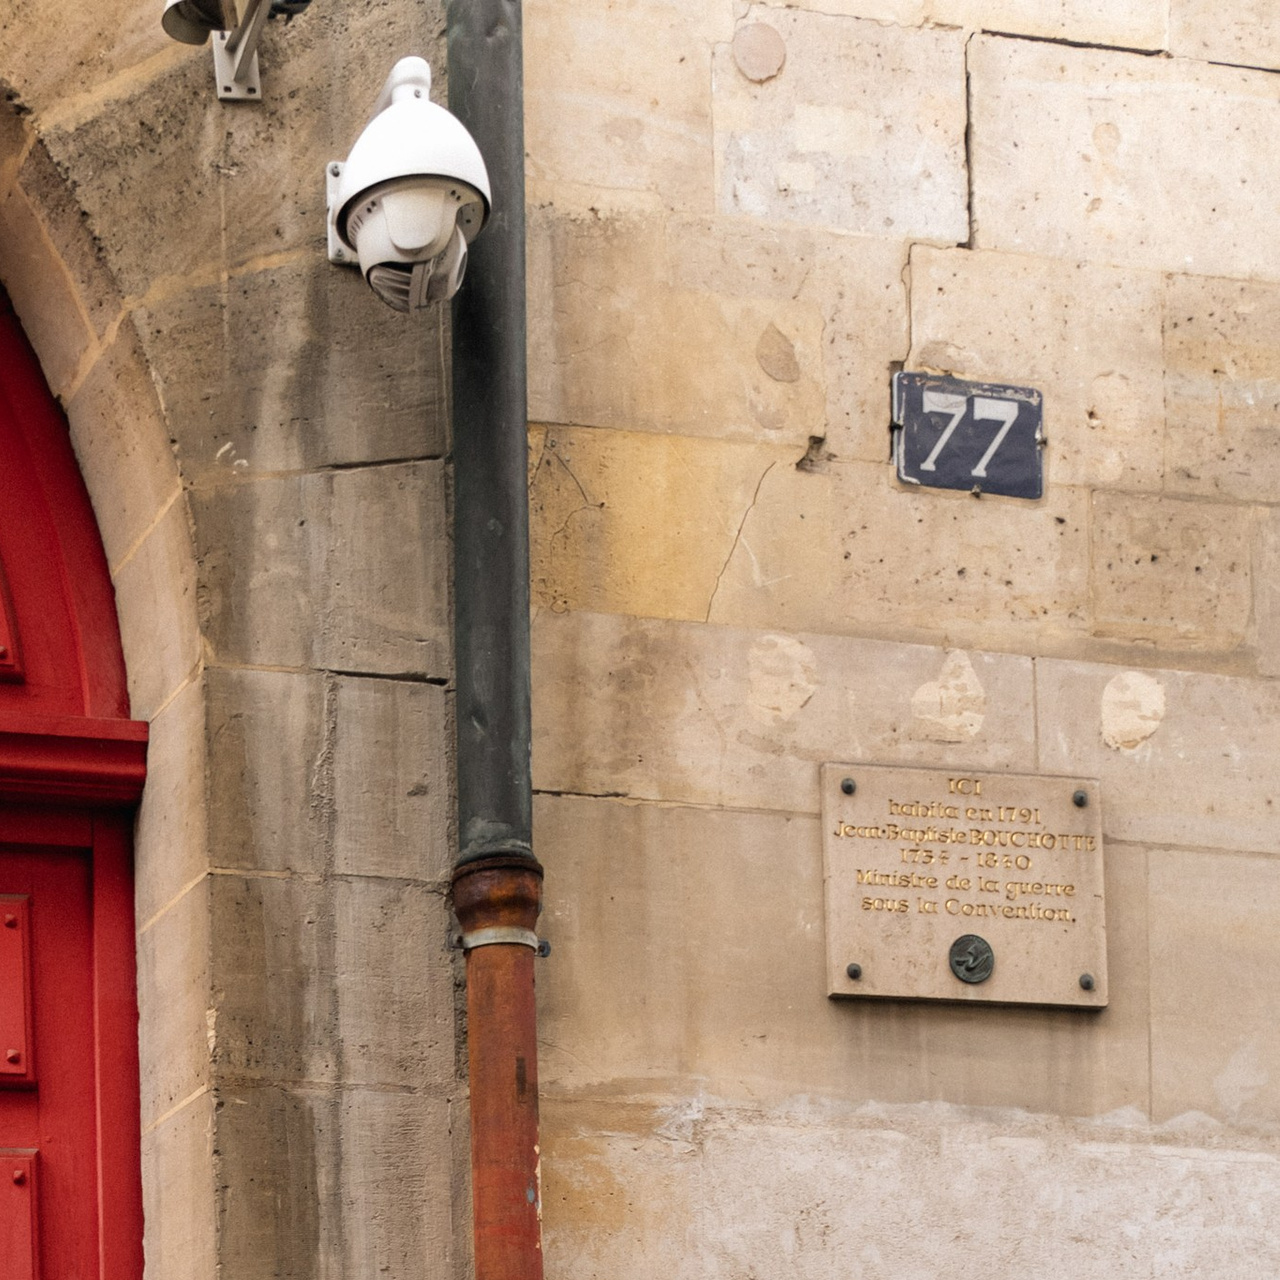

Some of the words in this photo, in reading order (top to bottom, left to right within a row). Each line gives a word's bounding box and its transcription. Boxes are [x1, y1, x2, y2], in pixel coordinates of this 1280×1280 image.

[920, 390, 1019, 478] 77
[948, 778, 982, 796] ICI
[888, 799, 959, 819] habita
[965, 807, 993, 822] en
[969, 828, 1097, 852] BOUCHOTTE
[900, 848, 950, 865] 1754
[977, 852, 1033, 871] 1840
[856, 868, 938, 889] Ministre
[945, 874, 972, 891] de
[978, 876, 1000, 893] la
[1005, 881, 1077, 901] guerre
[862, 896, 910, 913] sous
[917, 897, 939, 914] la
[945, 898, 1077, 923] Convention.
